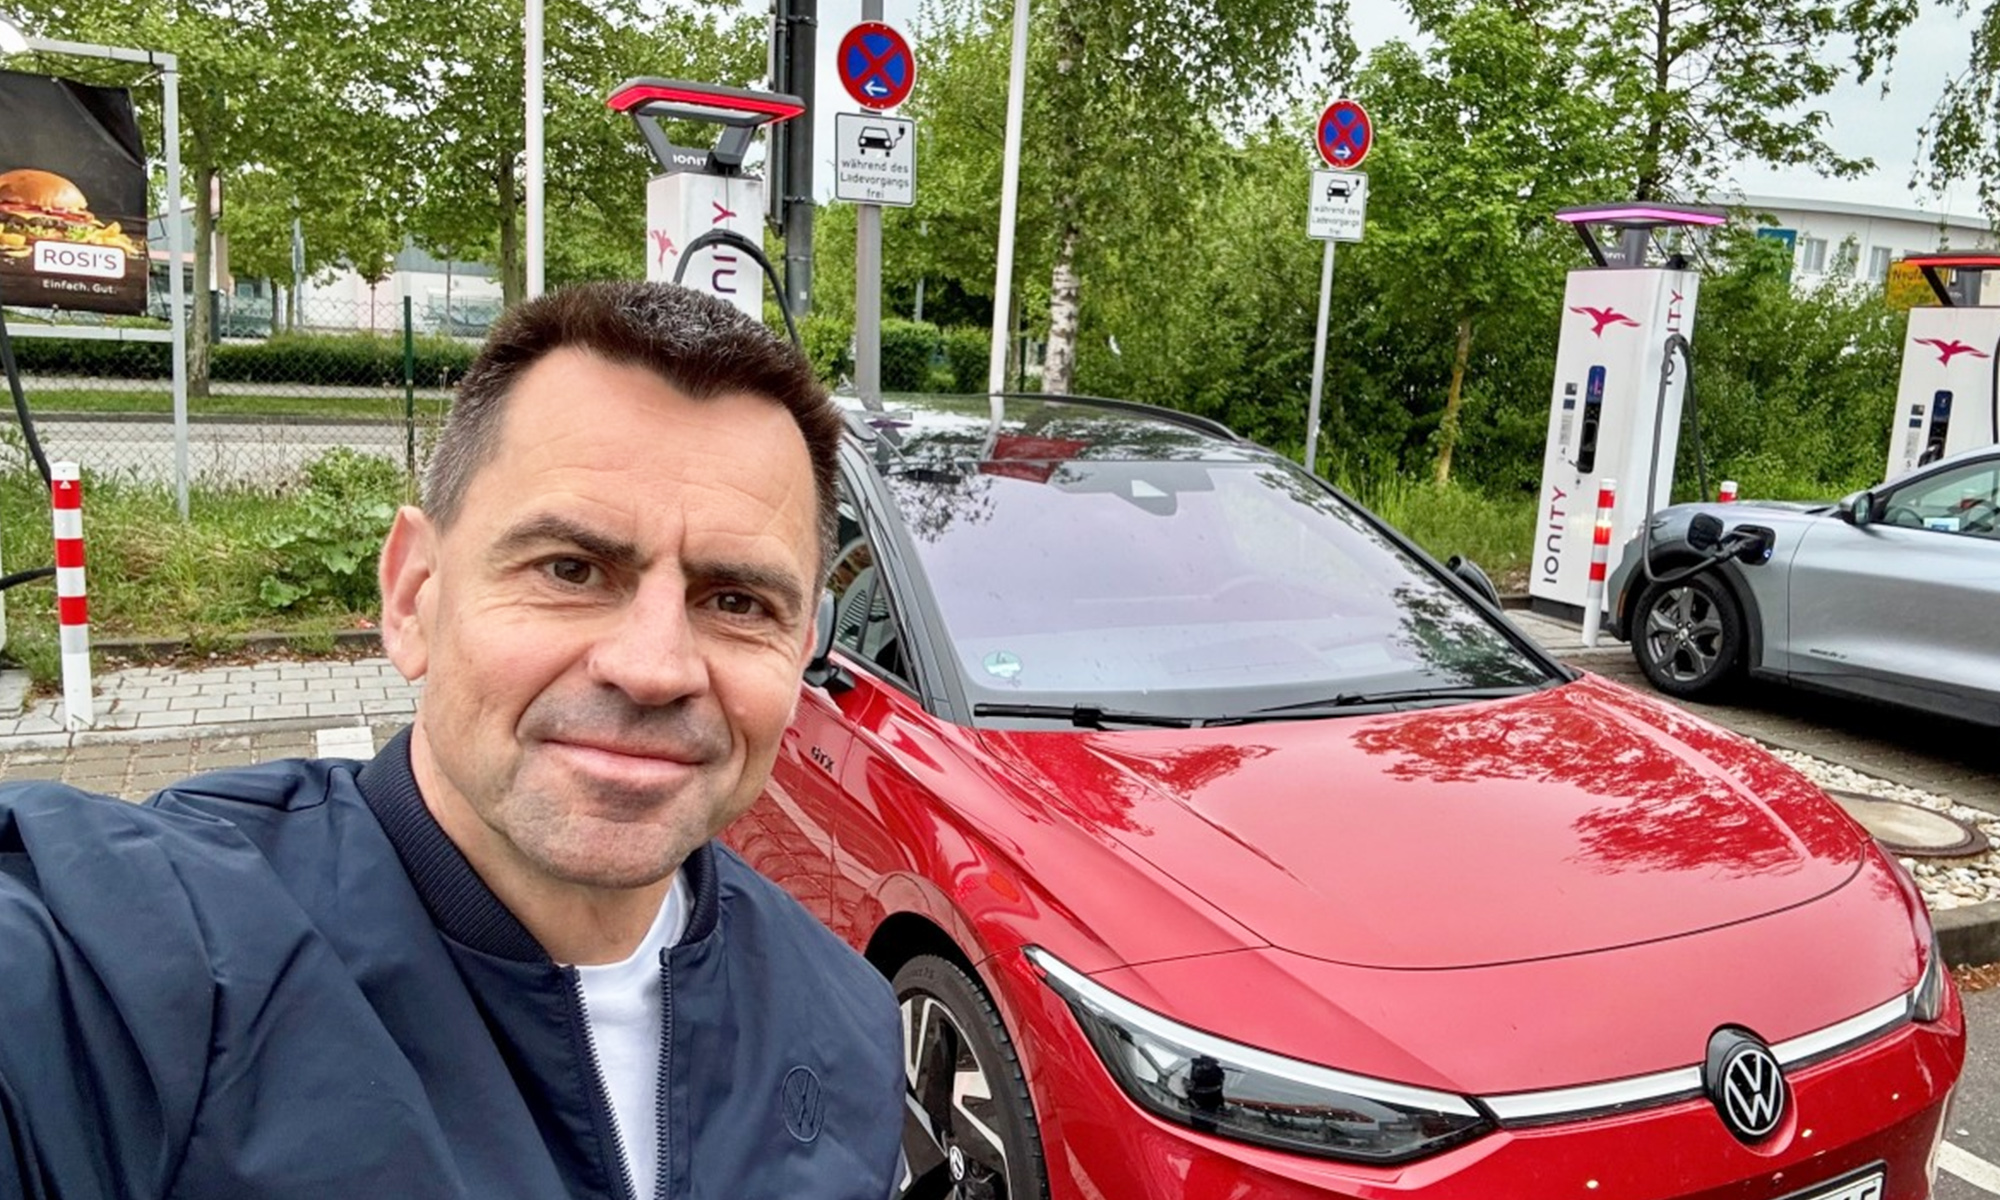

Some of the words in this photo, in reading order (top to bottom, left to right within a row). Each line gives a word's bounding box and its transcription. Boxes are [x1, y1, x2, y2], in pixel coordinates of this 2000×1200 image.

[672, 154, 707, 166] IONIT
[842, 159, 887, 171] während
[890, 163, 909, 173] des
[841, 172, 909, 190] Ladevorgangs
[867, 188, 884, 198] frei
[43, 249, 117, 270] ROSI'S
[43, 280, 90, 292] Einfach.
[93, 284, 117, 294] Gut.
[1543, 486, 1567, 584] IONITY
[811, 746, 834, 773] GTX
